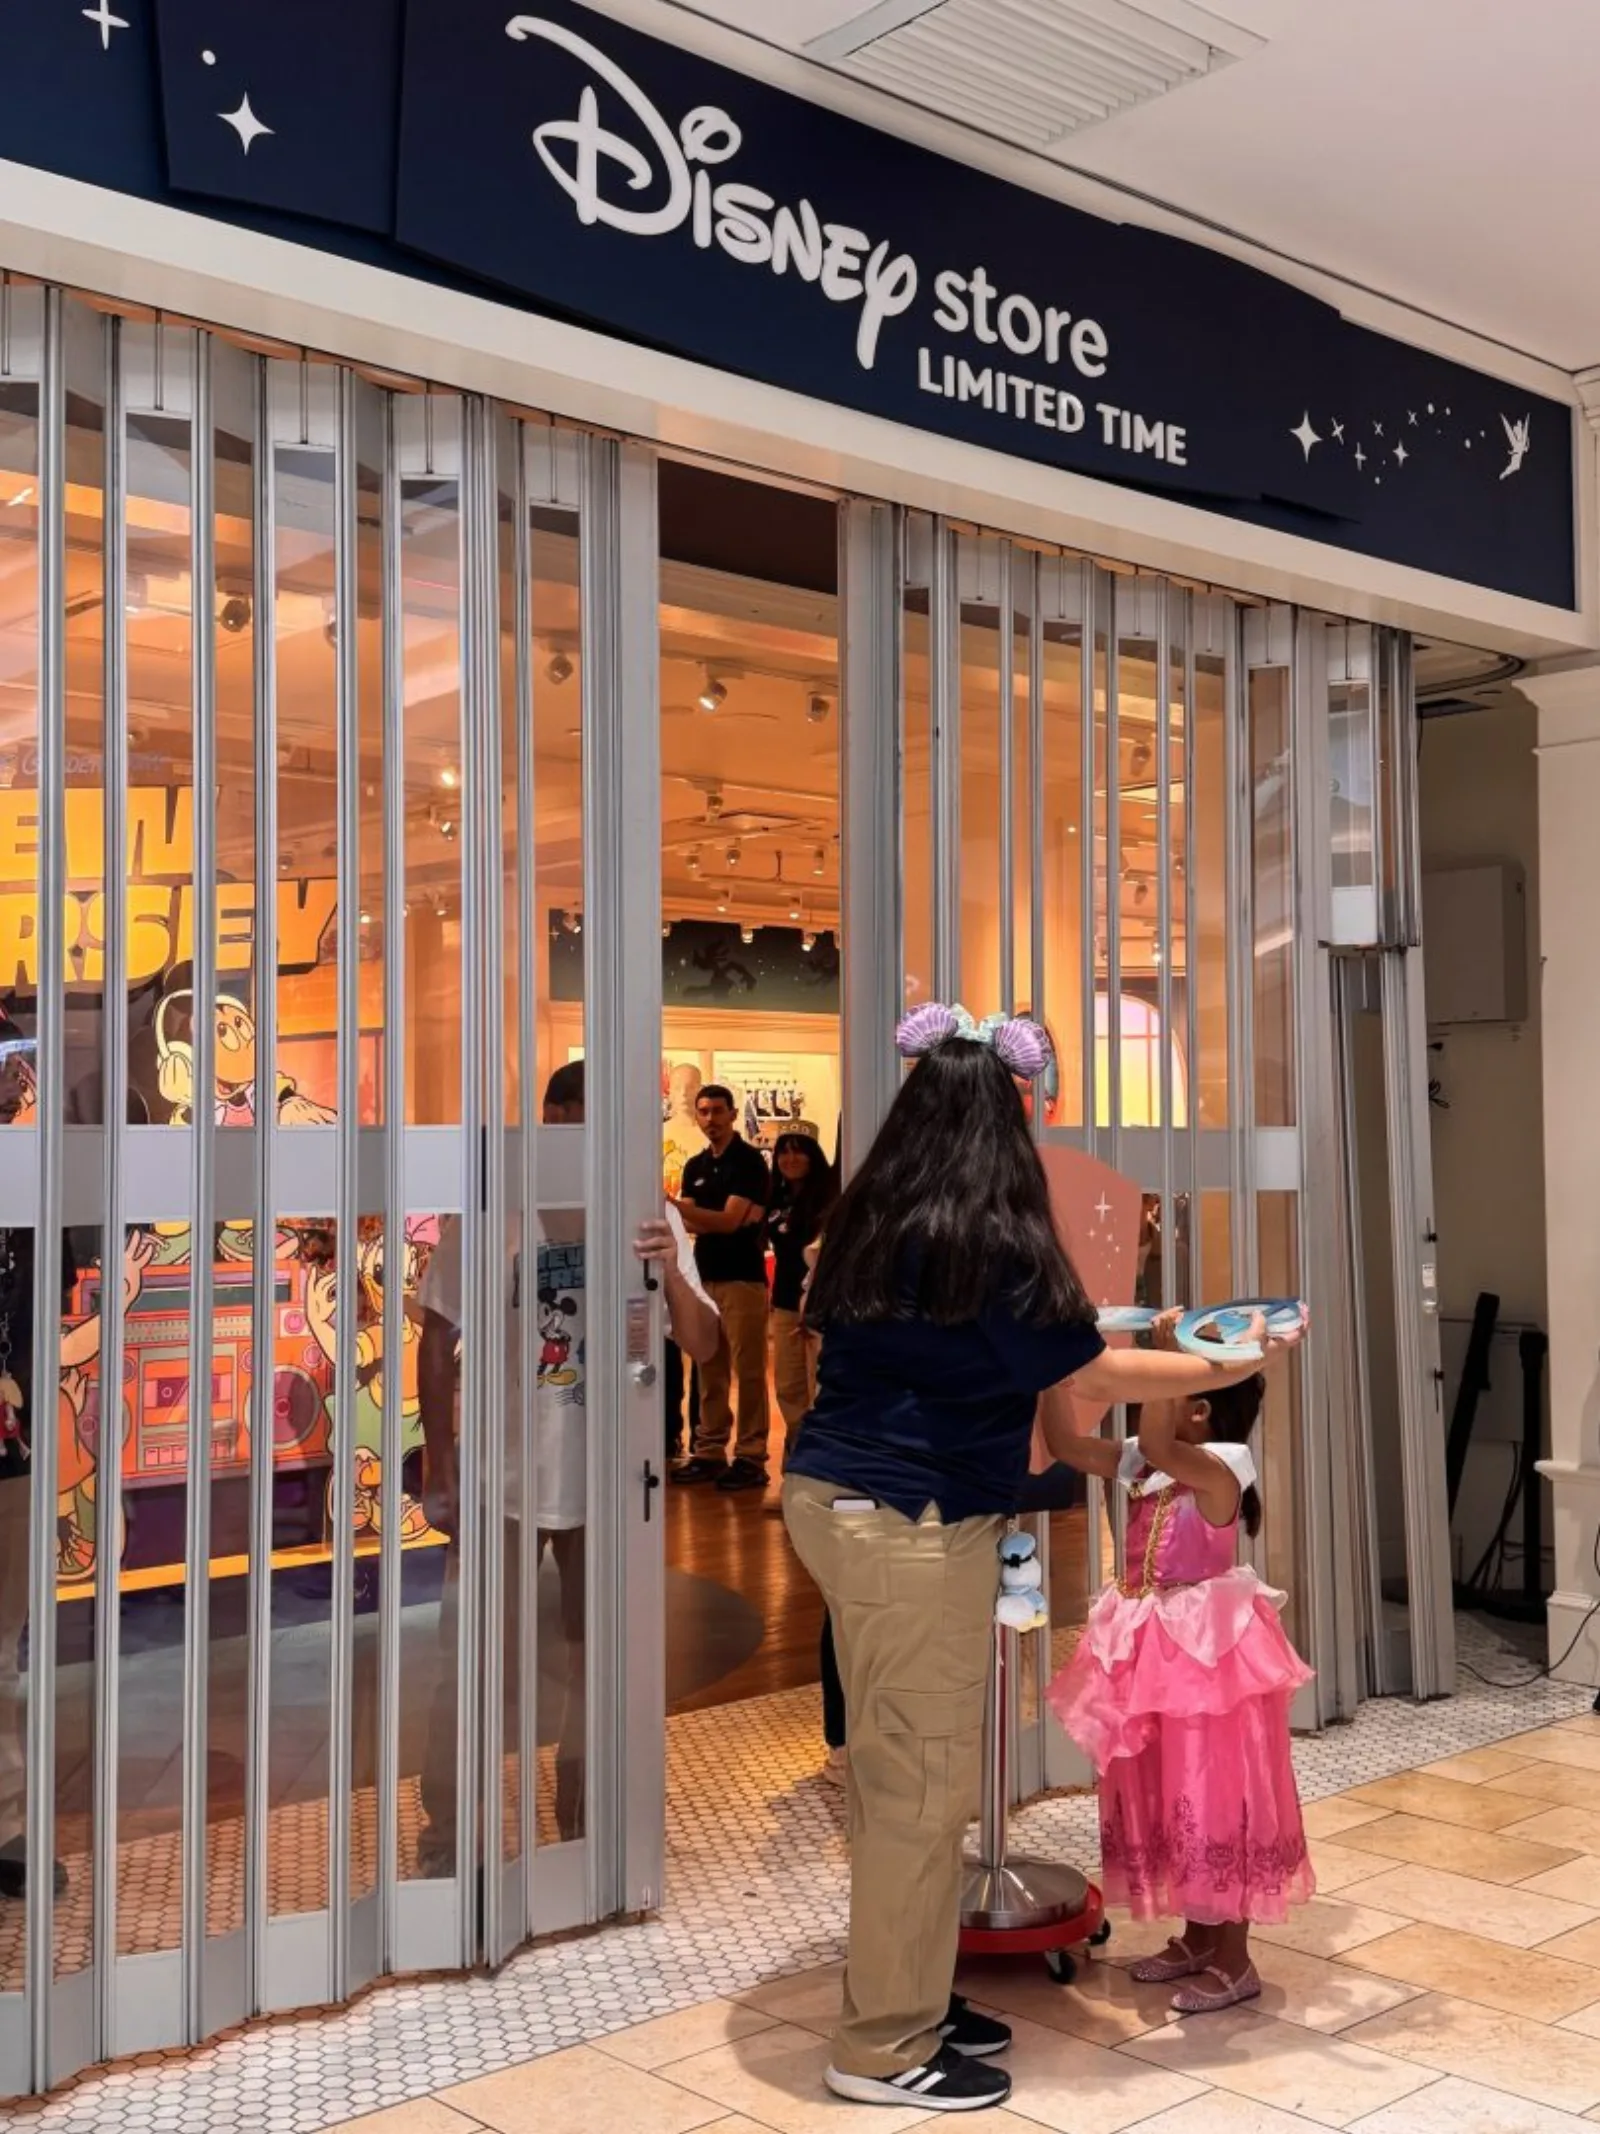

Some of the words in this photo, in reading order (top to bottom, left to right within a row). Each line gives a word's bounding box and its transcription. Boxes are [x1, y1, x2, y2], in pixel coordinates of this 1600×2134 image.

[933, 266, 1108, 378] store
[918, 347, 1085, 433] LIMITED
[1095, 402, 1187, 466] TIME
[0, 879, 346, 987] RSEY
